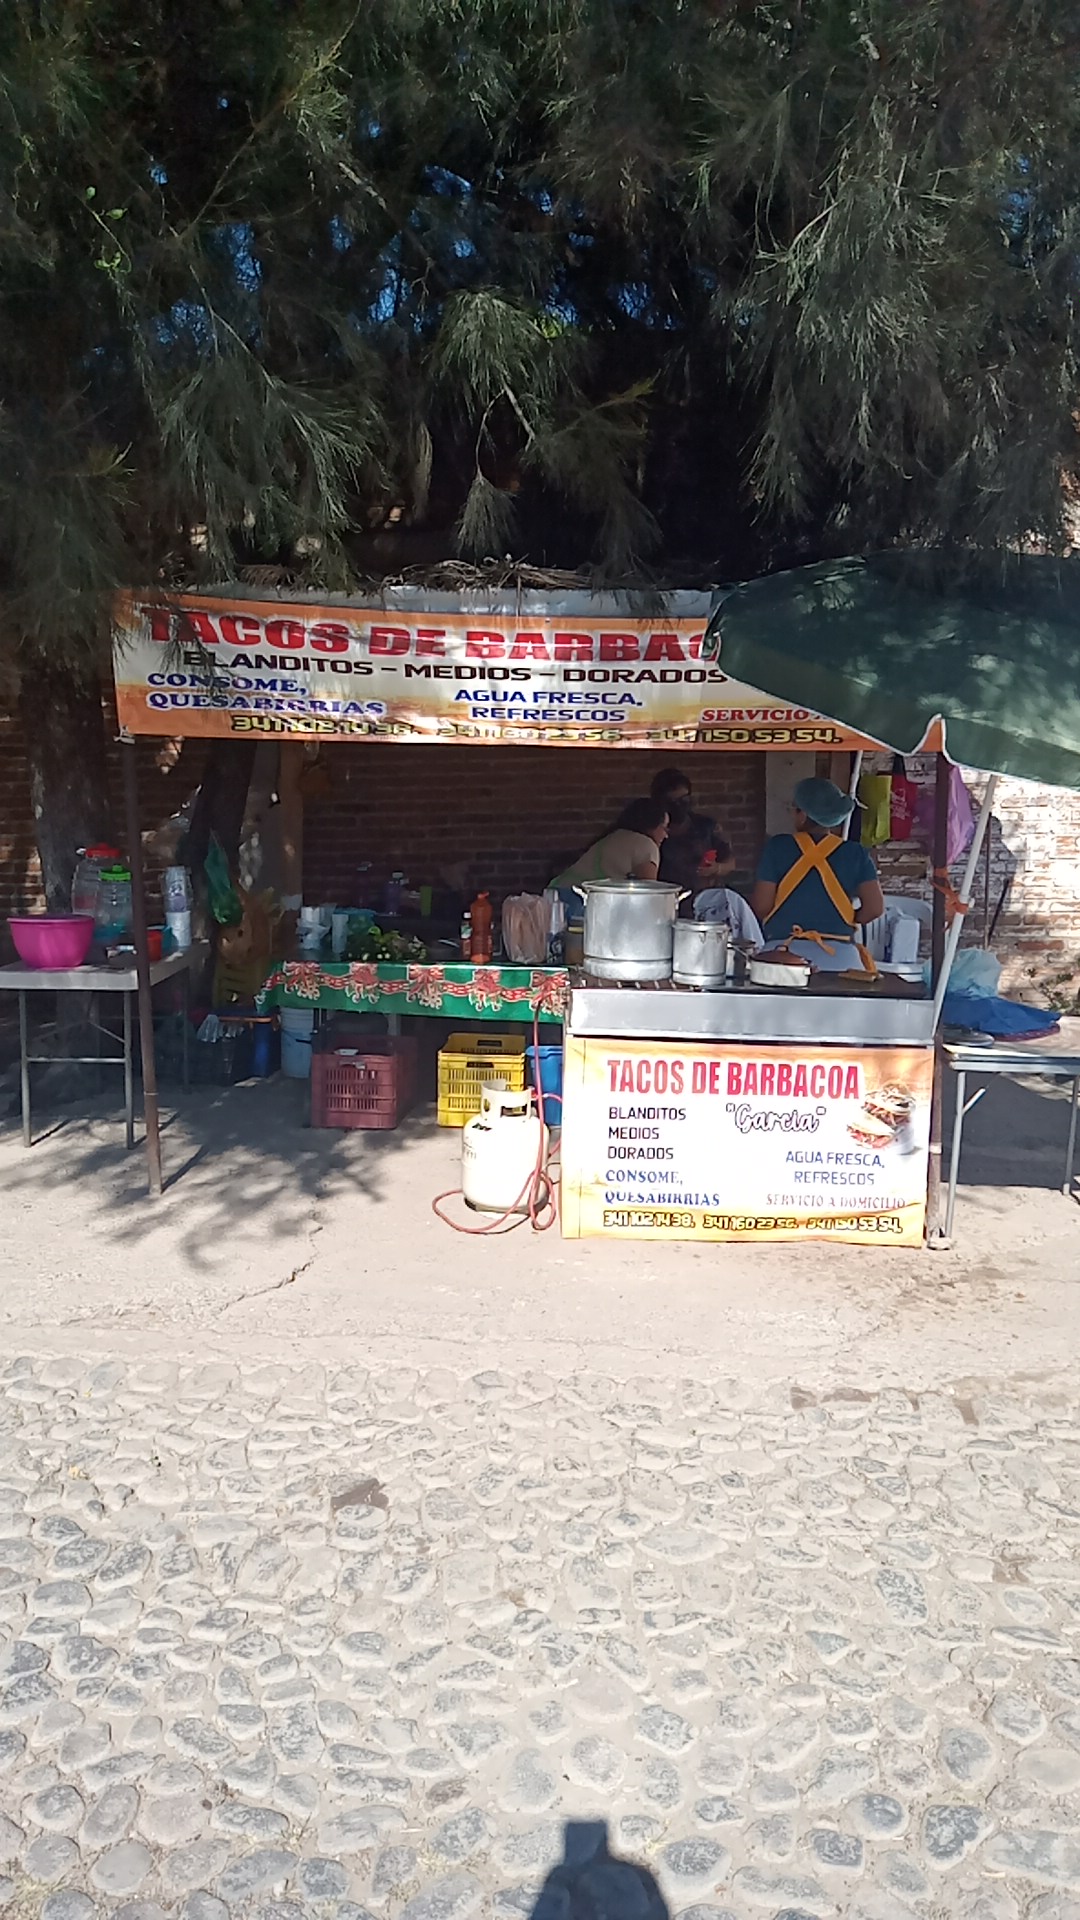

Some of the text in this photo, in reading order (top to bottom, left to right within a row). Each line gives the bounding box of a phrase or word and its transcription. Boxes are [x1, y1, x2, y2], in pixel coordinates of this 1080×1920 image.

[141, 607, 350, 654] TACOS
[368, 626, 447, 657] DE
[184, 651, 373, 675] BLANDITOS
[404, 663, 532, 682] MEDIOS
[562, 667, 729, 684] DORADOS
[148, 673, 308, 696] CONSOME,
[454, 689, 527, 703] AGUA
[149, 693, 385, 716] QUESABIRRIAS
[471, 706, 626, 722] REFRESCOS
[702, 708, 810, 721] SERVICIO
[233, 715, 284, 732] 341
[702, 728, 750, 744] 150
[753, 729, 792, 745] 53
[794, 729, 843, 745] 54.
[607, 1060, 860, 1099] TACOS DE BARBACOA
[608, 1107, 687, 1121] BLANDITOS
[608, 1126, 660, 1140] MEDIOS
[607, 1146, 674, 1160] DORADOS
[785, 1151, 824, 1164] AGUA
[605, 1169, 683, 1186] CONSOME,
[794, 1171, 875, 1186] REFRESCOS
[604, 1190, 720, 1207] QUESABIRRIAS
[766, 1193, 824, 1207] SERVICIO
[840, 1197, 906, 1209] DOMICILIO
[603, 1210, 629, 1227] 341
[629, 1211, 655, 1227] 102
[655, 1212, 672, 1227] 14
[703, 1214, 729, 1229] 341
[730, 1216, 756, 1231] 160
[756, 1217, 776, 1230] 23
[858, 1216, 879, 1232] 53
